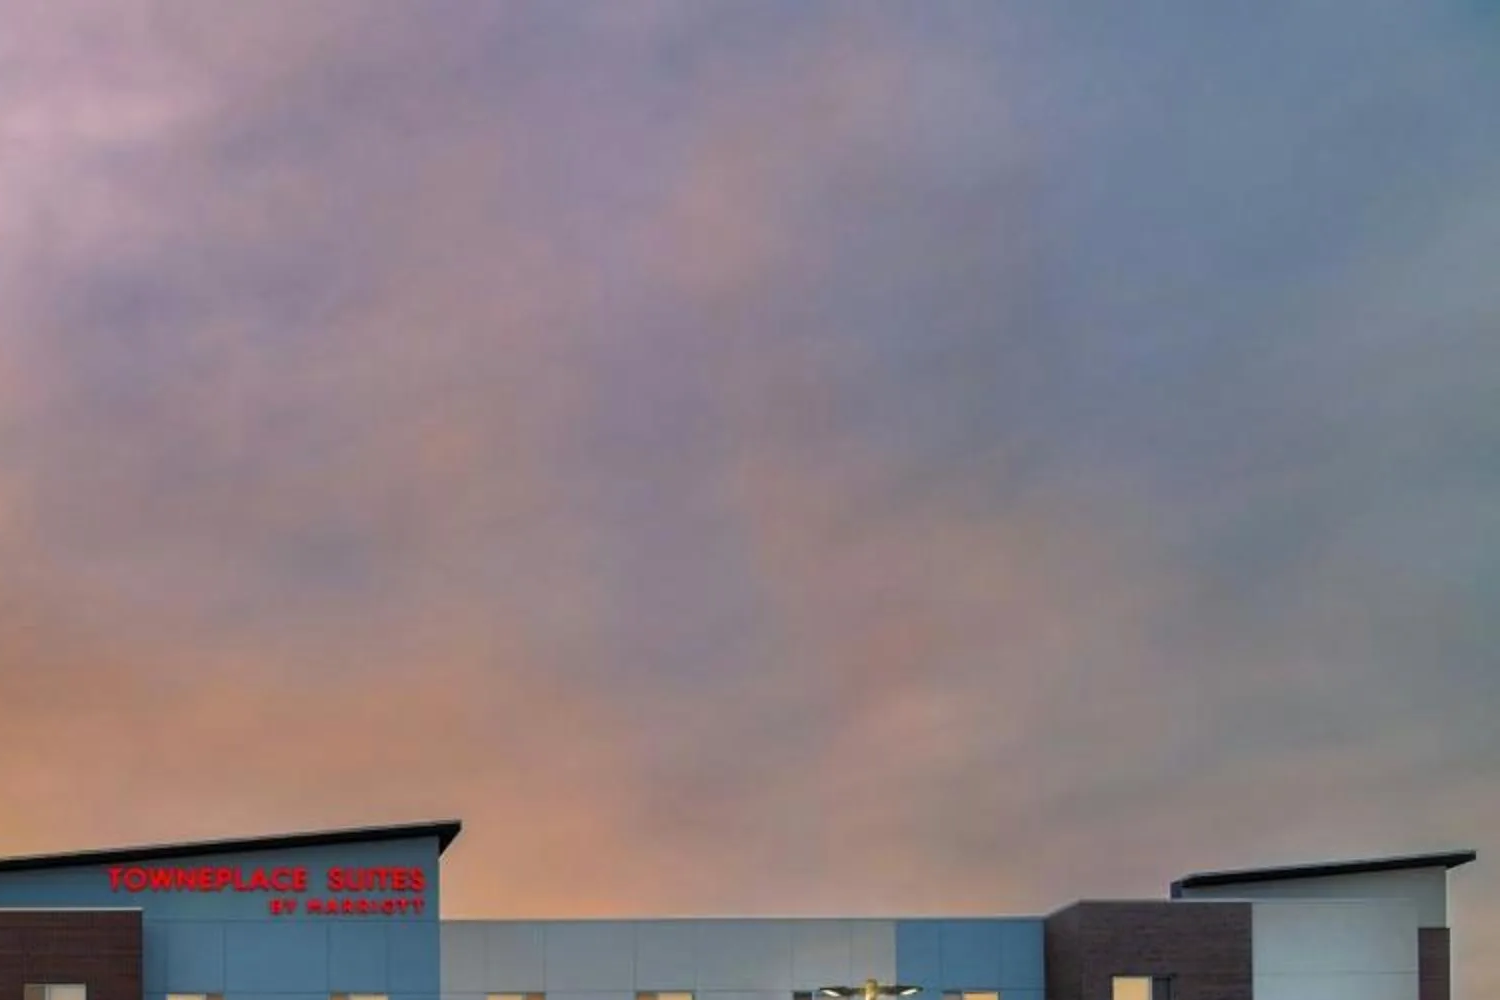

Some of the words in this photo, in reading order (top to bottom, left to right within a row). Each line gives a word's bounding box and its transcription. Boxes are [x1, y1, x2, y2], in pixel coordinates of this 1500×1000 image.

[108, 866, 307, 892] TOWNEPLACE
[327, 866, 425, 892] SUITES
[269, 899, 297, 914] BY
[306, 899, 425, 915] MARRIOTT
